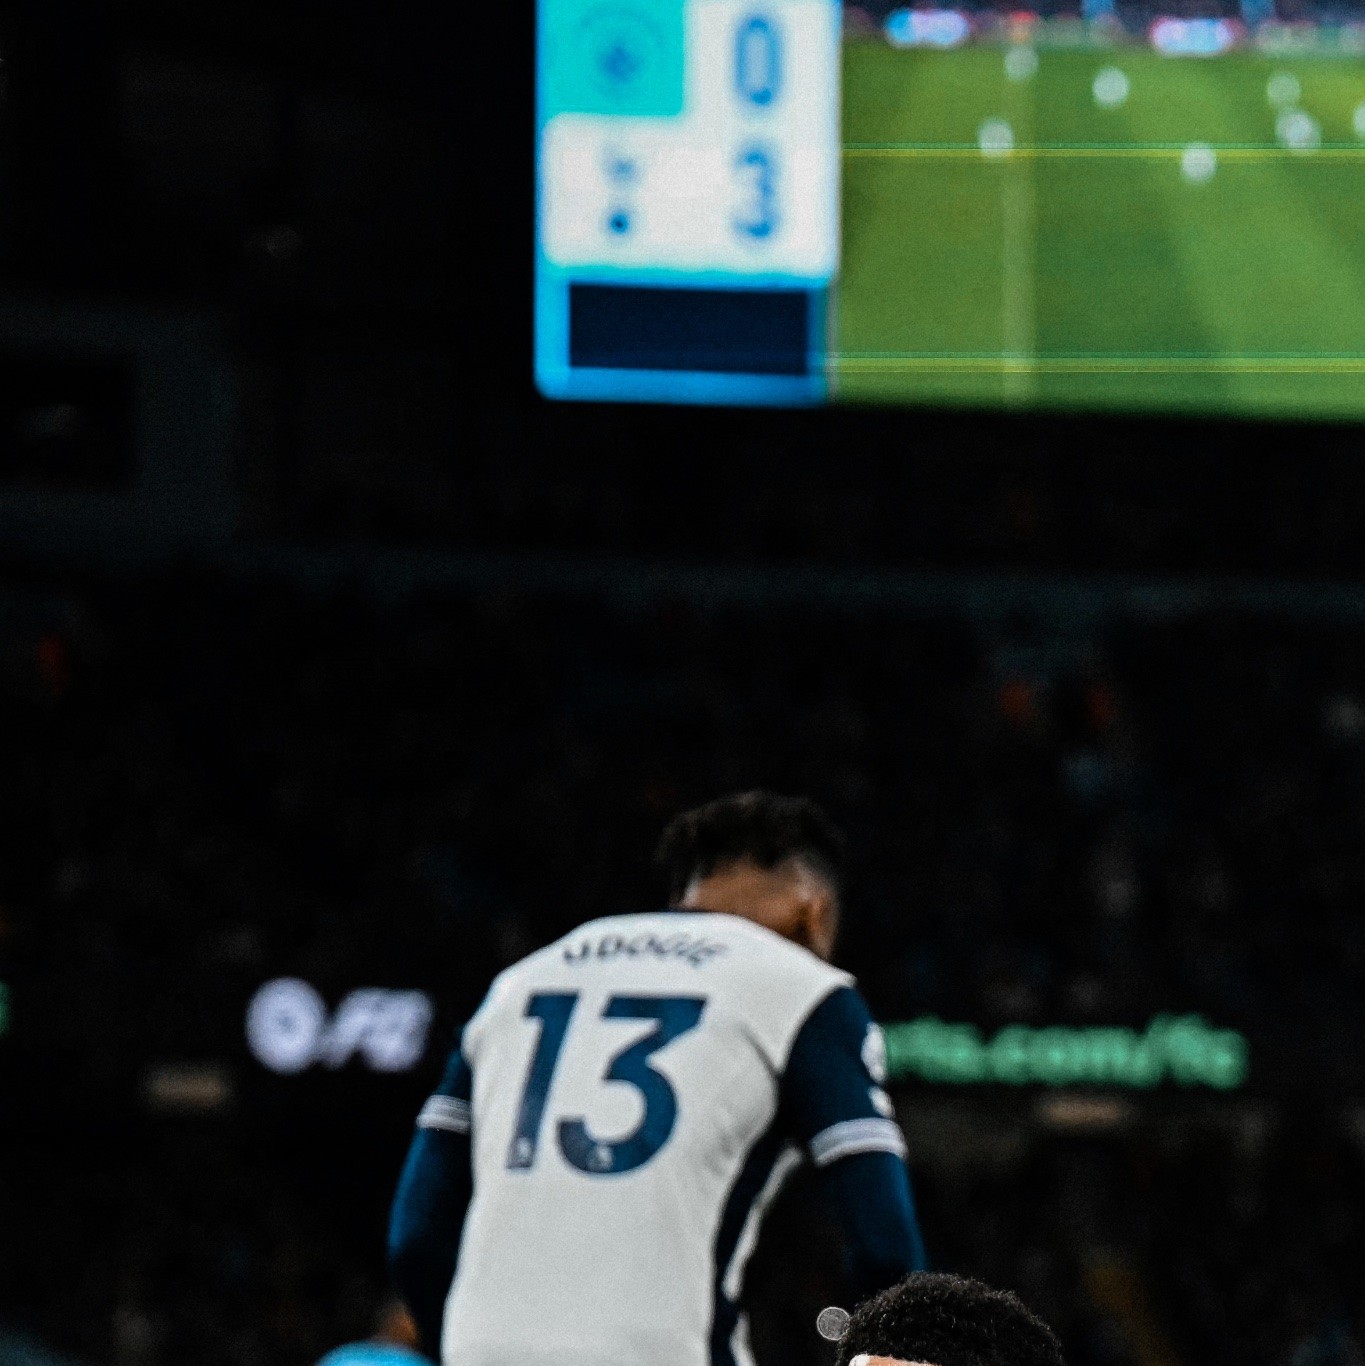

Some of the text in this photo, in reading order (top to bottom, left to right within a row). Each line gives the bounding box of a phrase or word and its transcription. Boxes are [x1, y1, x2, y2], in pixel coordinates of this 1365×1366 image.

[733, 12, 782, 106] 0
[733, 148, 780, 240] 3
[506, 991, 708, 1175] 13
